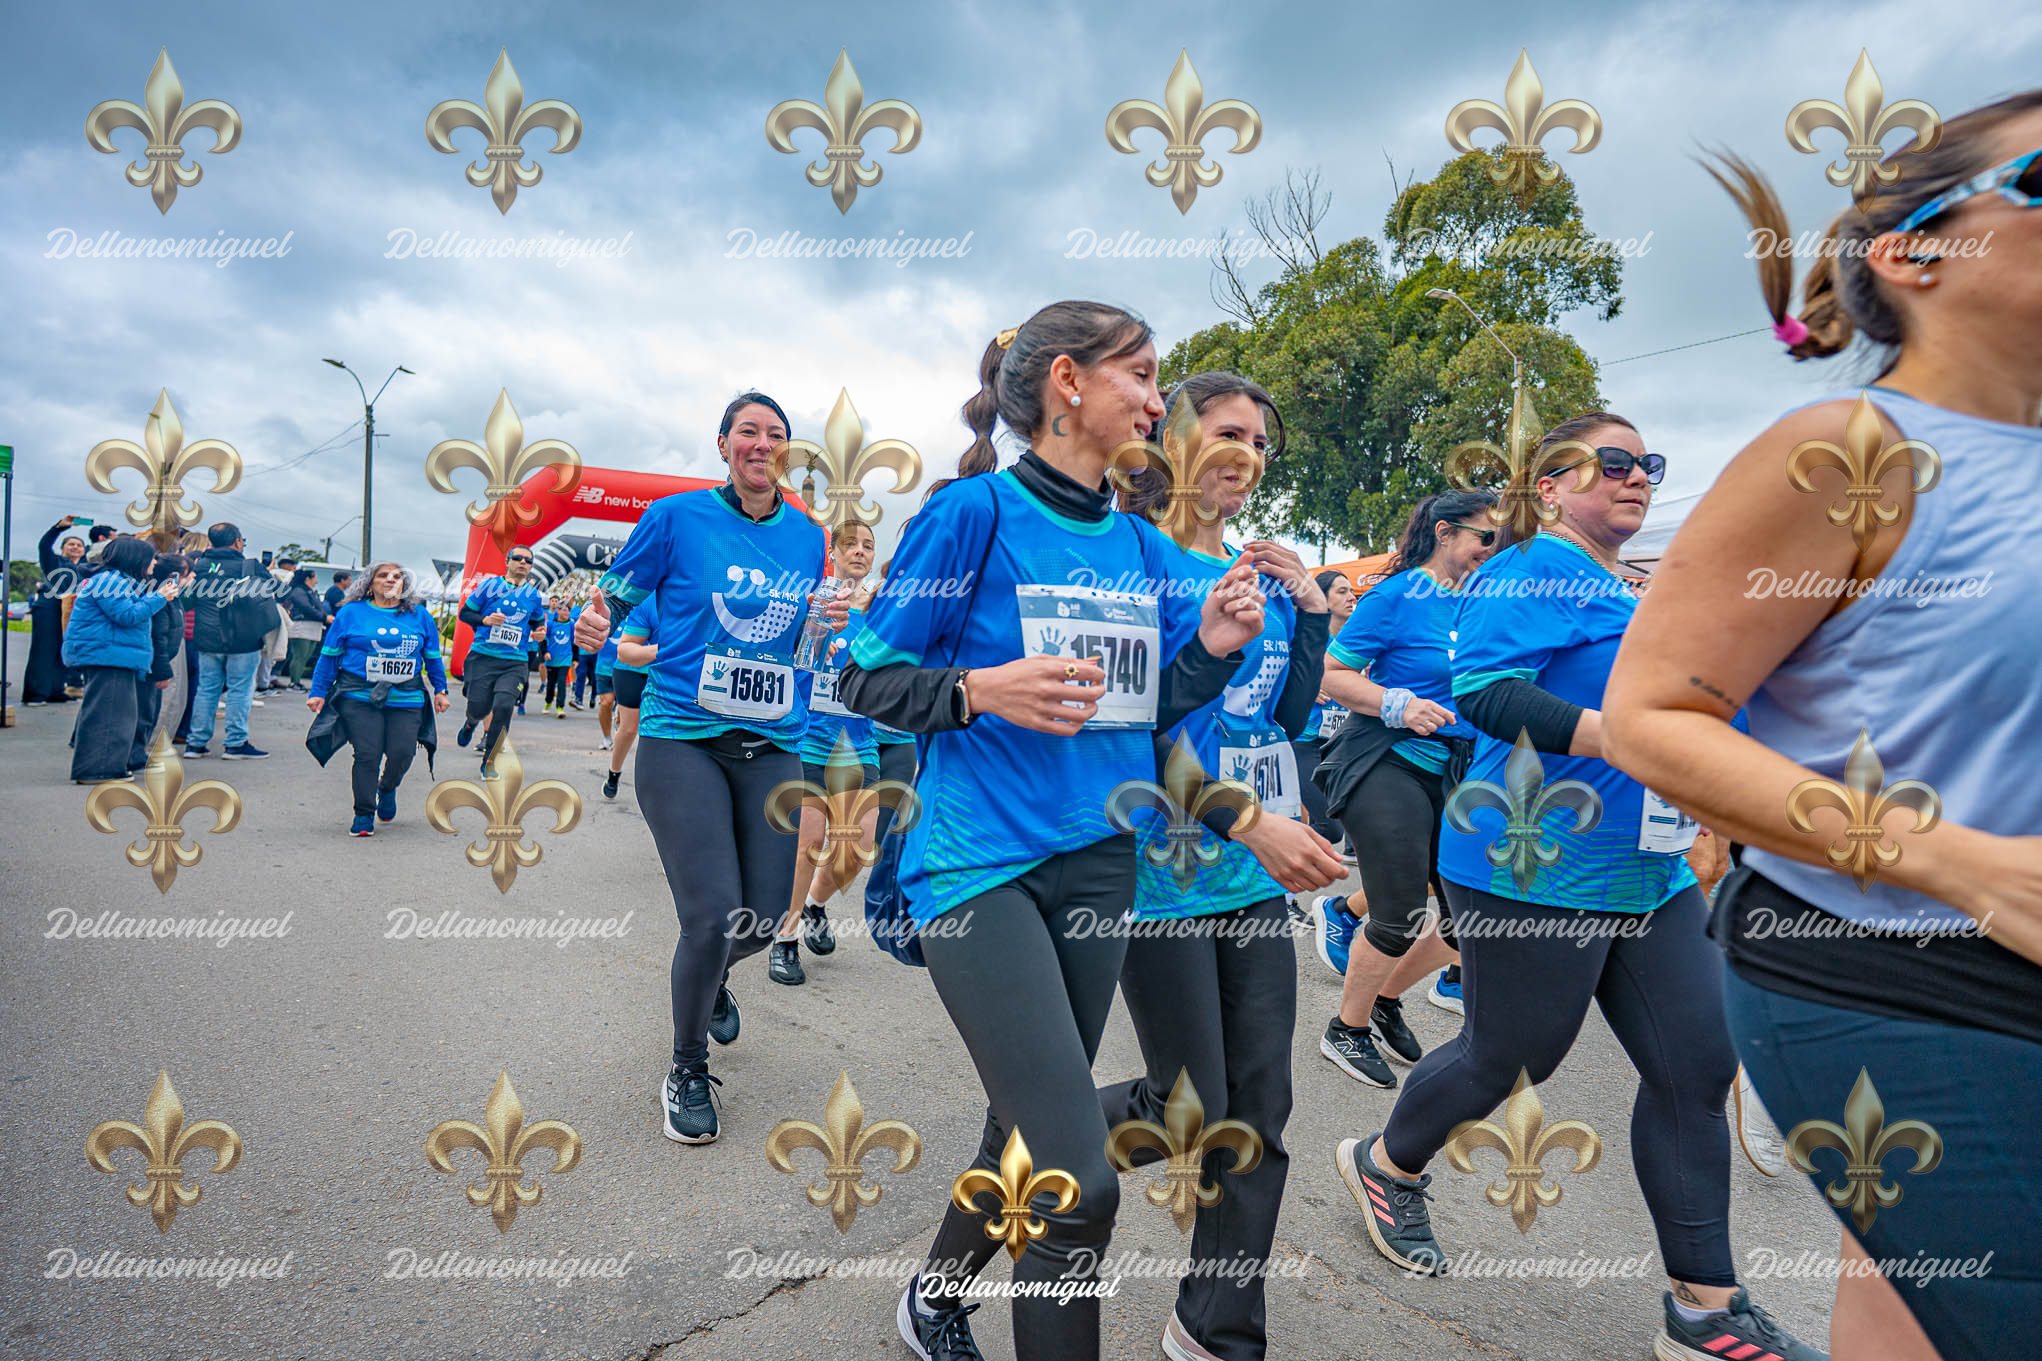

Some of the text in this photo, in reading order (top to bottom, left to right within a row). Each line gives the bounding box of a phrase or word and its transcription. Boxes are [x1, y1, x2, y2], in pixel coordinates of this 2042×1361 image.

[604, 496, 631, 508] new
[381, 661, 413, 675] 16622
[730, 667, 786, 705] 15831
